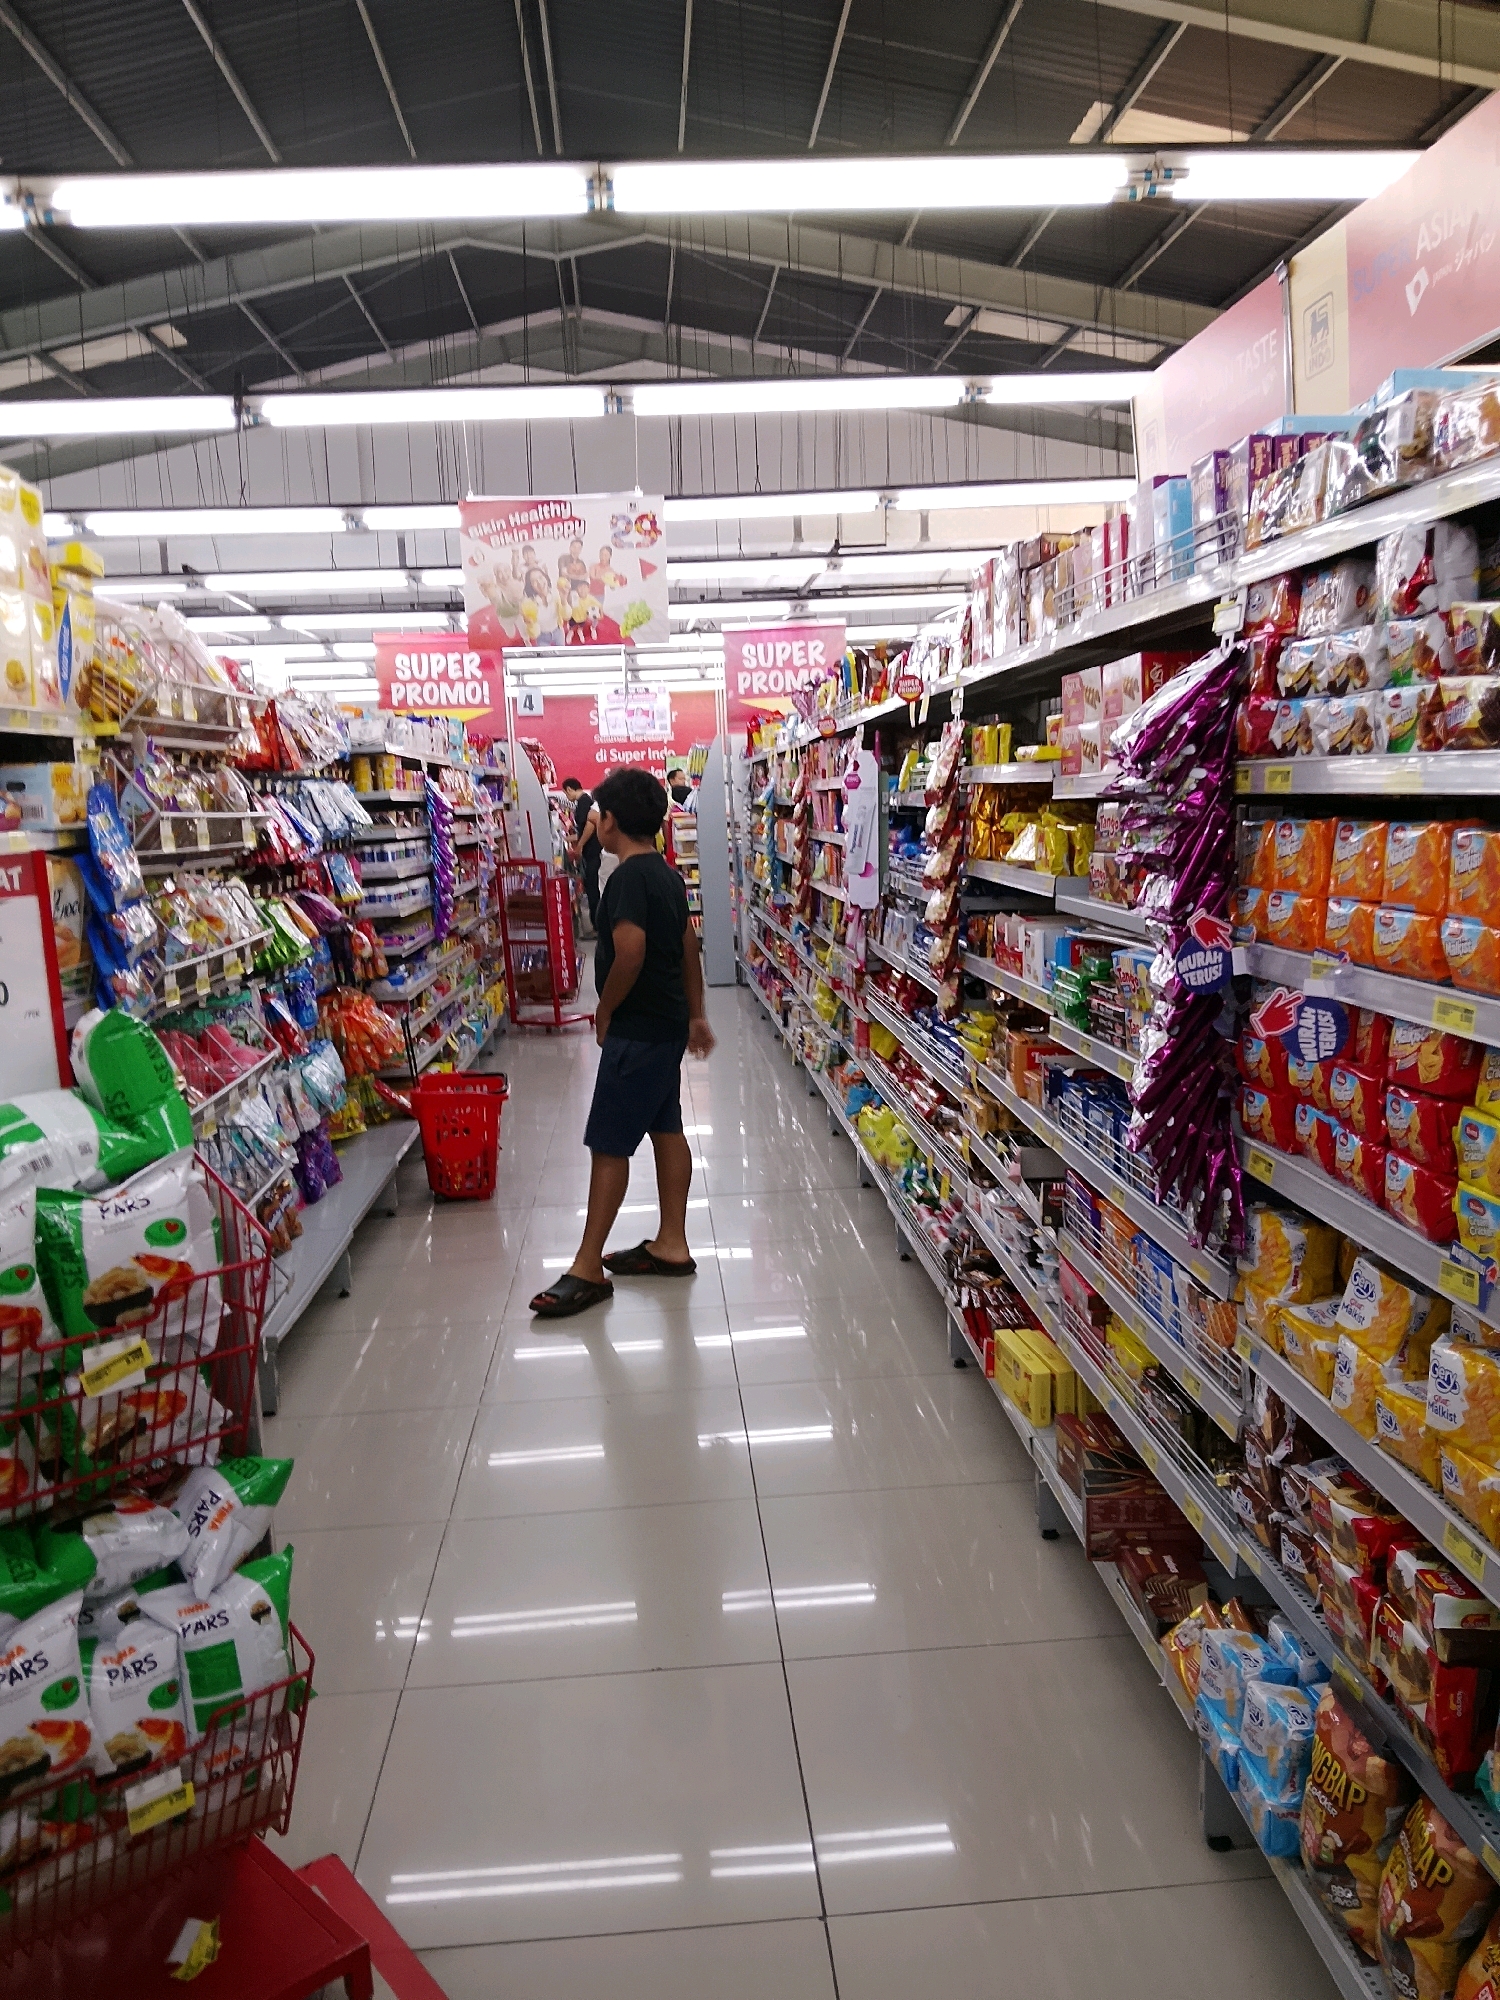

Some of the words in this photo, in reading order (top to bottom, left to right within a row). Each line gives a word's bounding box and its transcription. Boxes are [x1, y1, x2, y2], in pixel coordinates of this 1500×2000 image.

[508, 500, 573, 528] Healthy
[531, 519, 587, 542] Happy
[610, 511, 663, 549] 29
[395, 651, 483, 681] SUPER
[742, 639, 826, 669] SUPER
[391, 680, 490, 707] PROMO!
[523, 692, 534, 711] 4
[595, 748, 607, 763] di
[609, 748, 646, 764] Super
[1099, 814, 1120, 836] Tango
[1177, 950, 1223, 975] MURAH
[1182, 964, 1223, 987] TERUS!
[1116, 967, 1139, 995] Tango
[1298, 1006, 1318, 1062] MURAH
[1317, 1008, 1337, 1059] TERUS!
[1352, 1269, 1376, 1302] Gery
[1341, 1302, 1366, 1326] Malkist
[1430, 1358, 1460, 1395] Gery
[1427, 1403, 1458, 1425] Malkist
[188, 1489, 222, 1539] PARS
[180, 1609, 230, 1639] PARS
[106, 1653, 158, 1687] PARS
